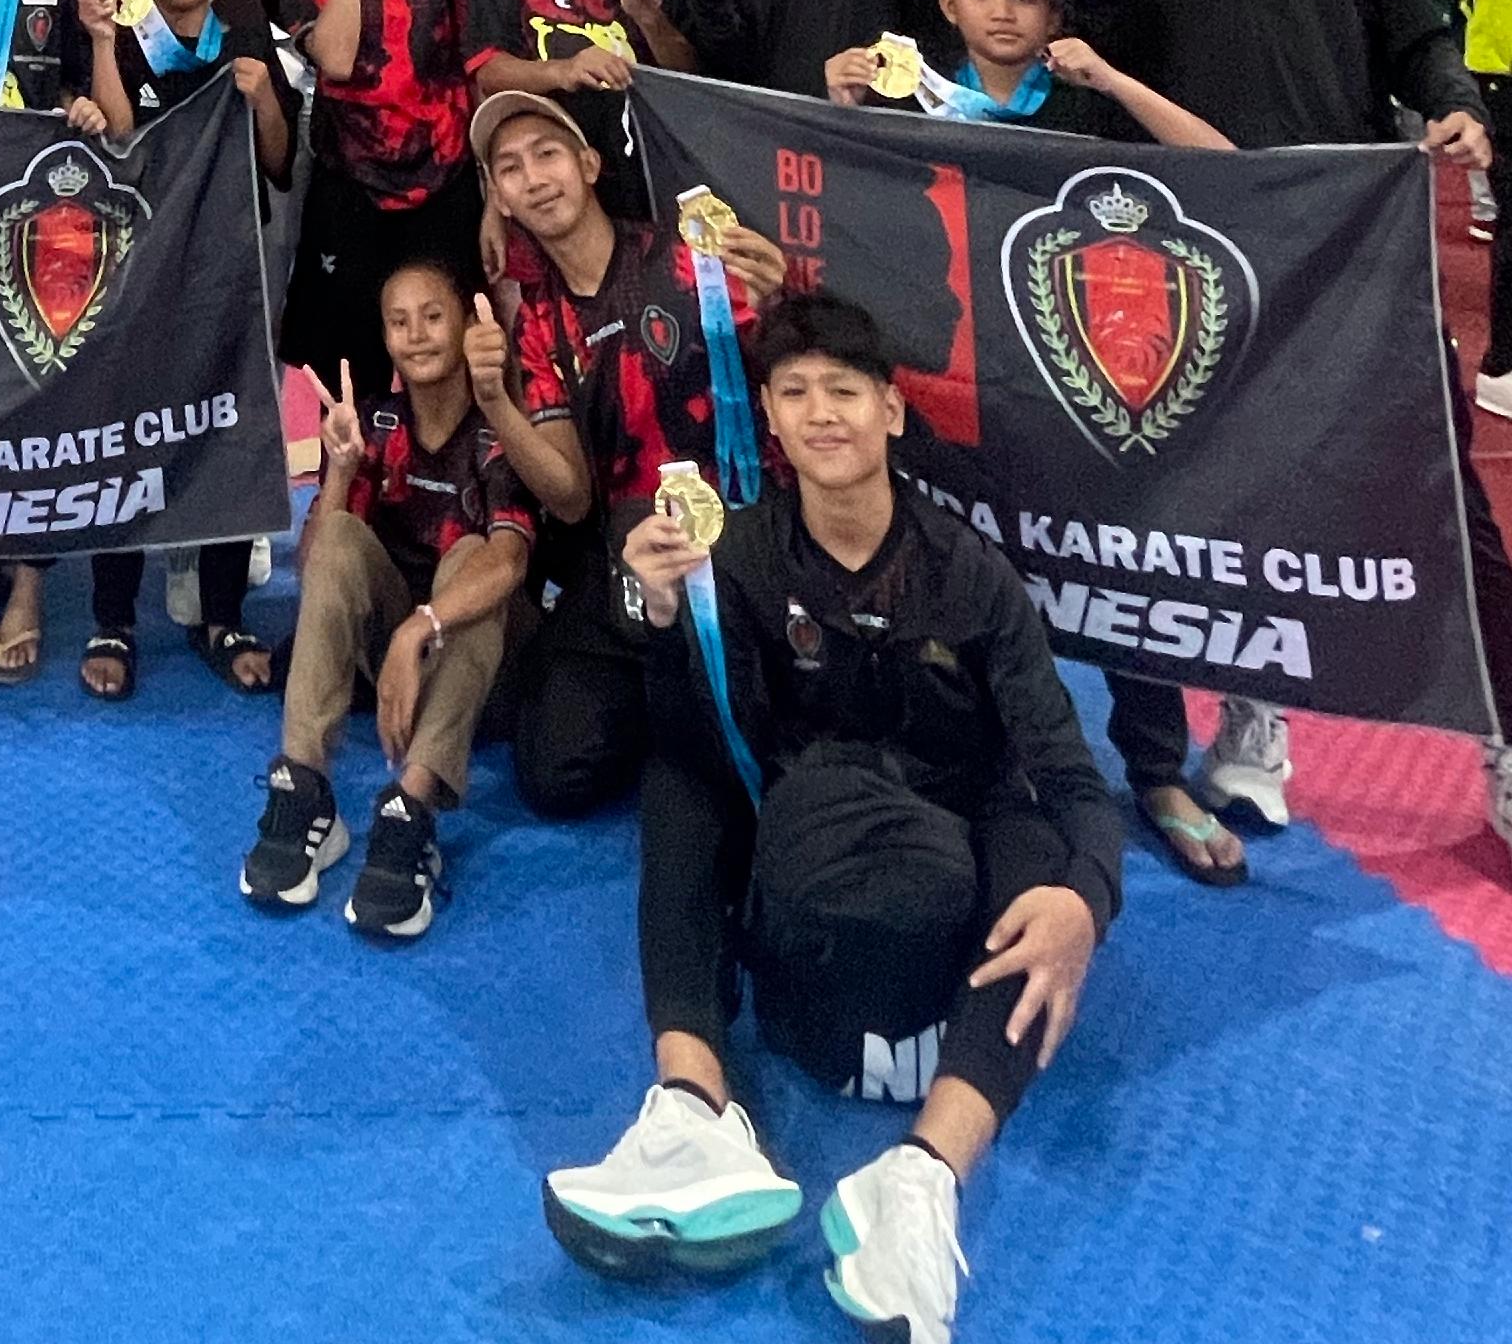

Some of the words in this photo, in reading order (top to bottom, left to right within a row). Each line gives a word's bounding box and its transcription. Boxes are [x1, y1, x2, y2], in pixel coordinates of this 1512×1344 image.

[777, 148, 822, 197] BO
[779, 201, 821, 248] LO
[134, 391, 240, 448] CLUB
[1018, 511, 1248, 587] KARATE
[1263, 547, 1417, 602] CLUB
[1025, 573, 1313, 680] NESIA
